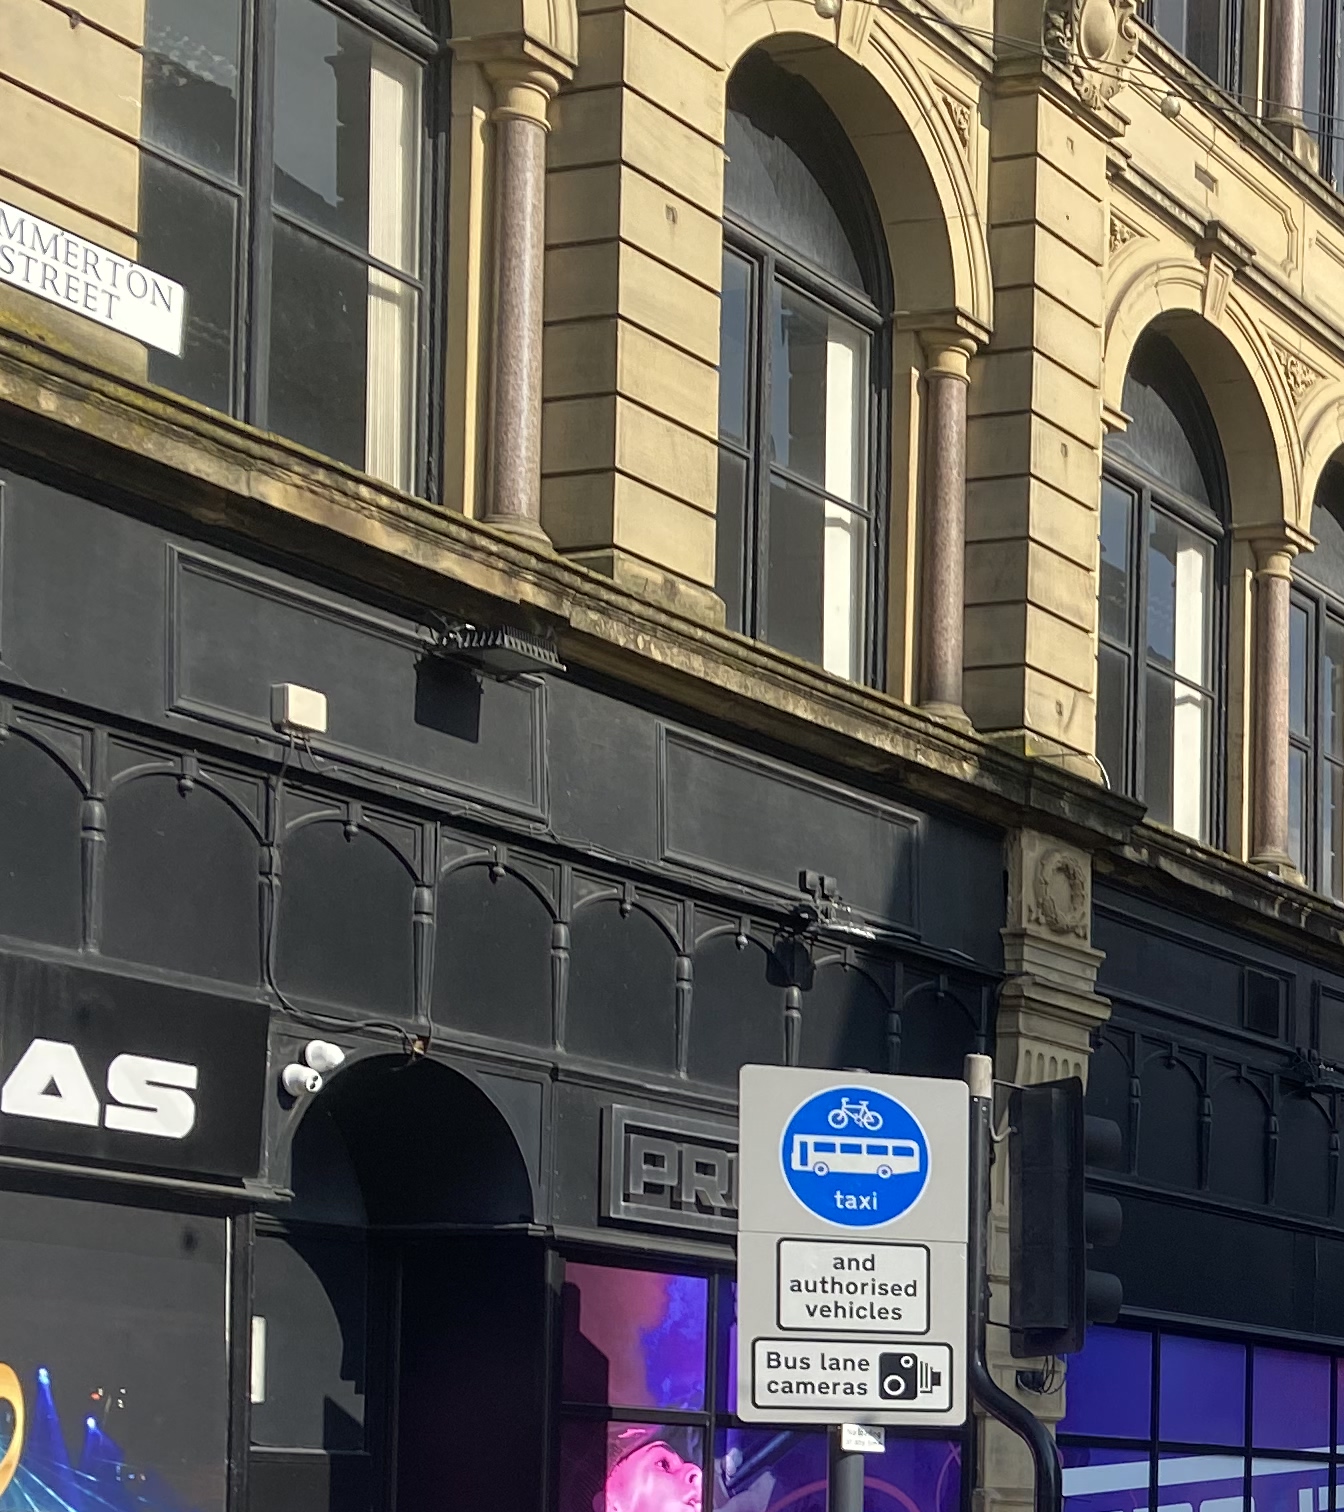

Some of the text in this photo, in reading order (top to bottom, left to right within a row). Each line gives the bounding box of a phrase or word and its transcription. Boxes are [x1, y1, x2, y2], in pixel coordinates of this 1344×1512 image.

[0, 244, 121, 320] STREET
[0, 1038, 198, 1139] AS
[834, 1190, 878, 1212] taxi
[833, 1254, 875, 1271] and
[789, 1276, 917, 1298] authorised
[805, 1301, 902, 1321] vehicles
[766, 1352, 870, 1372] Bus lane
[766, 1379, 868, 1396] cameras
